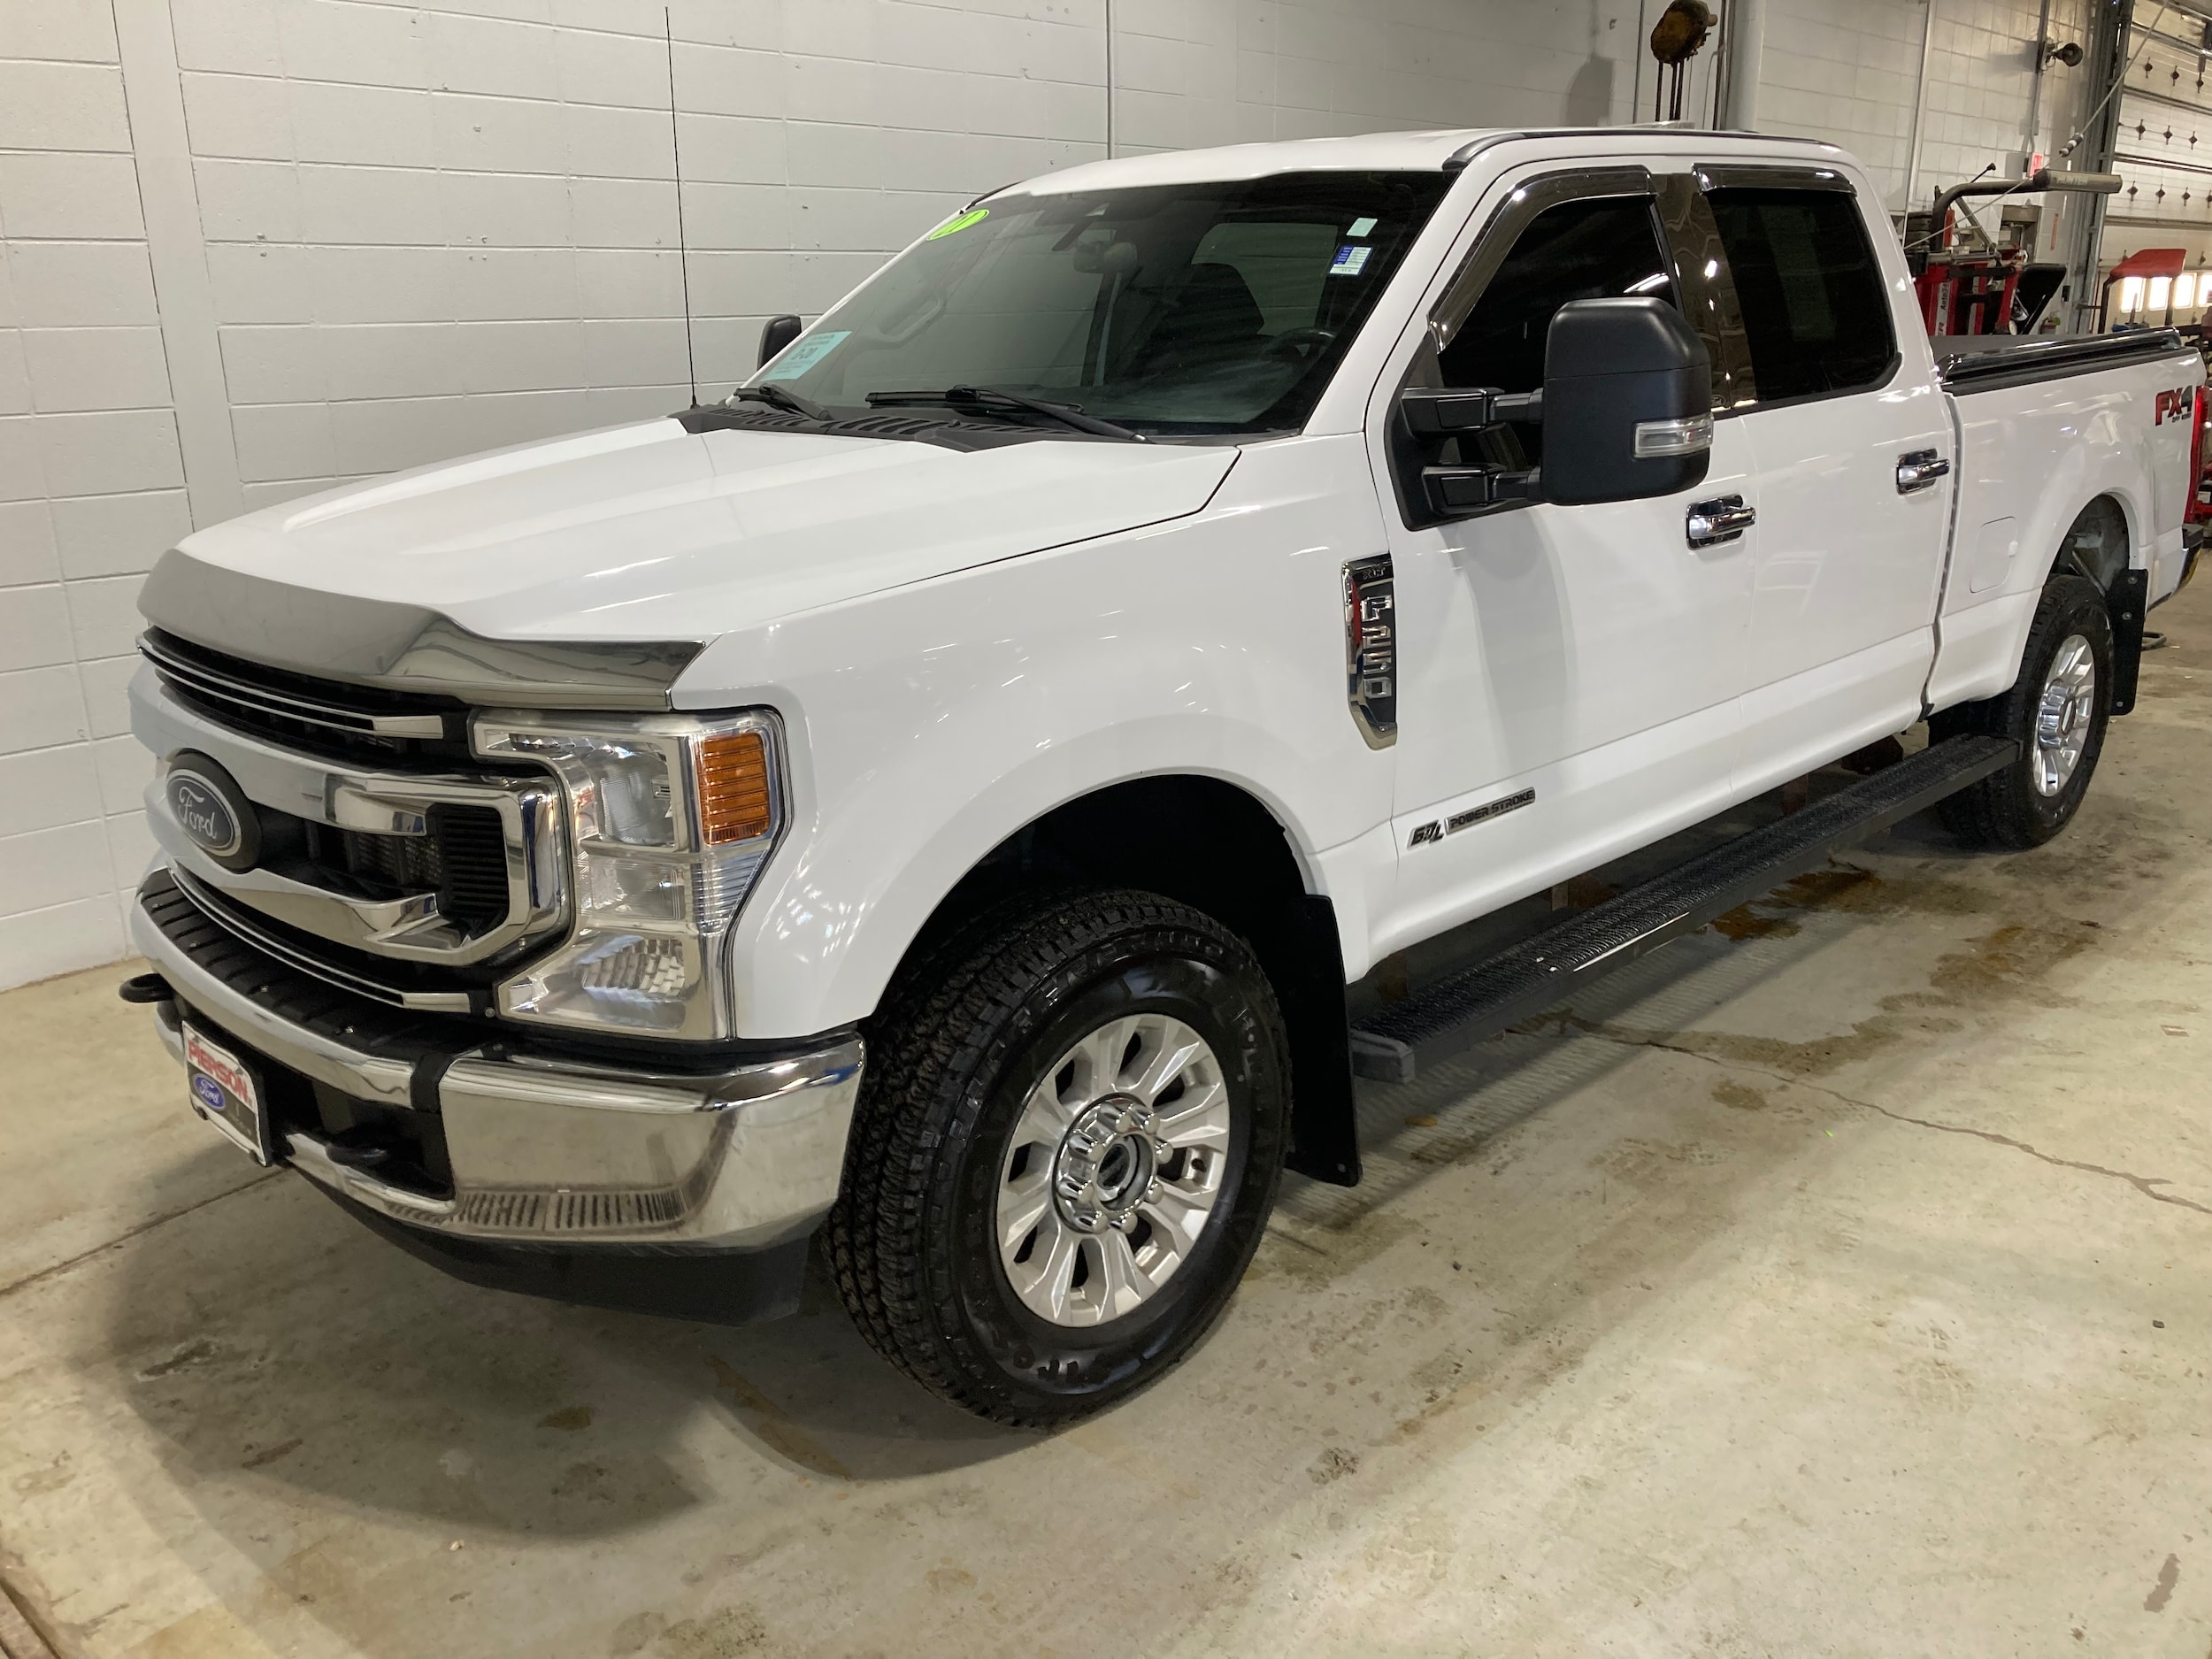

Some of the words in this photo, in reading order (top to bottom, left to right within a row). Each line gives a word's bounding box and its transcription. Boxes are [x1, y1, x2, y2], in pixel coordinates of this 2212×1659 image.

[2155, 385, 2193, 426] FX4
[178, 786, 218, 840] Ford
[1449, 808, 1489, 830] POWER
[1492, 790, 1534, 814] STROKE
[198, 1079, 221, 1105] Ford
